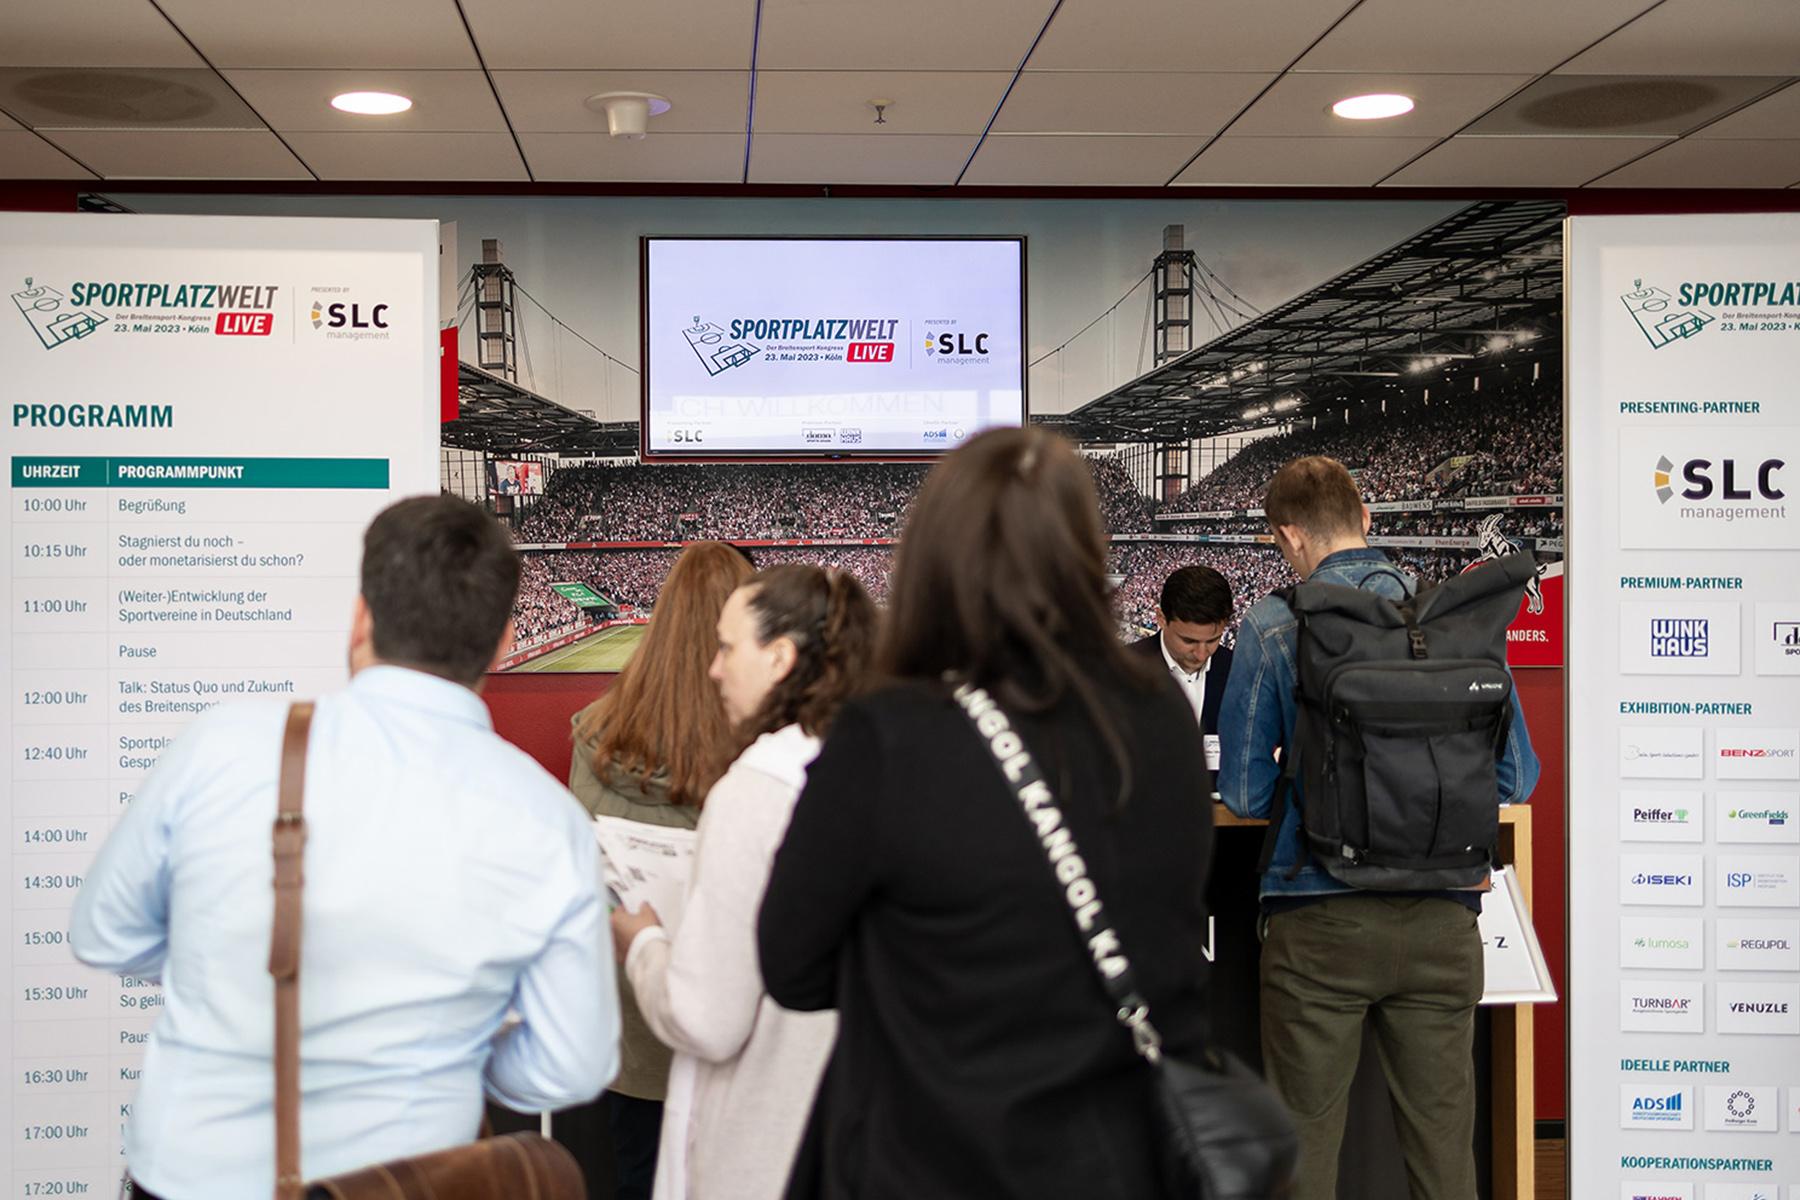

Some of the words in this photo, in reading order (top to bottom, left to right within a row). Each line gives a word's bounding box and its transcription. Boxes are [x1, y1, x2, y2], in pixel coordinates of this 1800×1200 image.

[70, 282, 279, 310] SPORTPLATZWELT
[328, 303, 389, 328] SLC
[114, 324, 130, 332] 23.
[154, 324, 180, 333] 2023
[188, 324, 210, 333] Köln
[222, 315, 265, 334] LIVE
[730, 318, 898, 340] SPORTPLATZWELT
[1720, 322, 1736, 331] 23.
[1760, 322, 1786, 331] 2023
[326, 332, 390, 341] management
[938, 333, 989, 355] SLC
[853, 346, 888, 360] LIVE
[938, 357, 990, 366] management
[1620, 402, 1760, 414] PRESENTING-PARTNER
[13, 404, 173, 428] PROGRAMM
[674, 430, 703, 442] SLC
[22, 465, 81, 478] UHRZEIT
[118, 466, 244, 479] PROGRAMMPUNKT
[1681, 459, 1785, 500] SLC
[24, 499, 62, 512] 10:00
[65, 499, 87, 512] Uhr
[118, 499, 186, 514] Begrüßung
[1680, 506, 1786, 522] management
[118, 535, 182, 550] Stagnierst
[184, 535, 200, 548] du
[203, 535, 234, 548] noch
[24, 545, 62, 558] 10:15
[65, 545, 87, 557] Uhr
[118, 554, 147, 566] oder
[149, 554, 238, 566] monetarisierst
[240, 554, 256, 566] du
[259, 554, 304, 566] schon?
[1620, 577, 1743, 589] PREMIUM-PARTNER
[118, 590, 245, 604] (Weiter-)Entwicklung
[247, 590, 268, 602] der
[24, 600, 62, 612] 11:00
[65, 600, 87, 612] Uhr
[118, 608, 198, 623] Sportvereine
[200, 608, 212, 622] in
[215, 608, 292, 622] Deutschland
[1652, 620, 1707, 638] WINK
[1506, 630, 1550, 642] ANDERS.
[119, 646, 157, 658] Pause
[1652, 638, 1708, 656] HAUS
[118, 681, 148, 694] Talk:
[150, 681, 191, 694] Status
[192, 681, 218, 694] Quo
[221, 680, 245, 694] und
[247, 680, 294, 693] Zukunft
[24, 692, 62, 704] 12:00
[65, 692, 88, 704] Uhr
[119, 700, 142, 712] des
[1620, 702, 1752, 714] EXHIBITION-PARTNER
[24, 747, 62, 760] 12:40
[65, 747, 88, 760] Uhr
[1634, 808, 1673, 820] Peiffer
[24, 830, 62, 842] 14:00
[66, 830, 88, 842] Uhr
[1017, 780, 1102, 931] KANGOL
[24, 876, 62, 889] 14:30
[1647, 875, 1692, 886] ISEKI
[1728, 872, 1752, 888] ISP
[24, 932, 62, 944] 15:00
[1648, 938, 1689, 949] lumosa
[1741, 940, 1790, 950] REGUPOL
[25, 988, 62, 1000] 15:30
[66, 988, 88, 1000] Uhr
[120, 995, 136, 1007] So
[1730, 1003, 1788, 1014] VENUZLE
[120, 1031, 150, 1043] Paus
[1620, 1059, 1670, 1072] IDEELLE
[1674, 1060, 1730, 1072] PARTNER
[25, 1070, 62, 1084] 16:30
[66, 1070, 88, 1082] Uhr
[1632, 1098, 1665, 1110] ADS
[25, 1126, 62, 1140] 17:00
[66, 1126, 88, 1138] Uhr
[1621, 1156, 1773, 1171] KOOPERATIONSPARTNER
[25, 1182, 62, 1195] 17:20
[66, 1182, 88, 1194] Uhr
